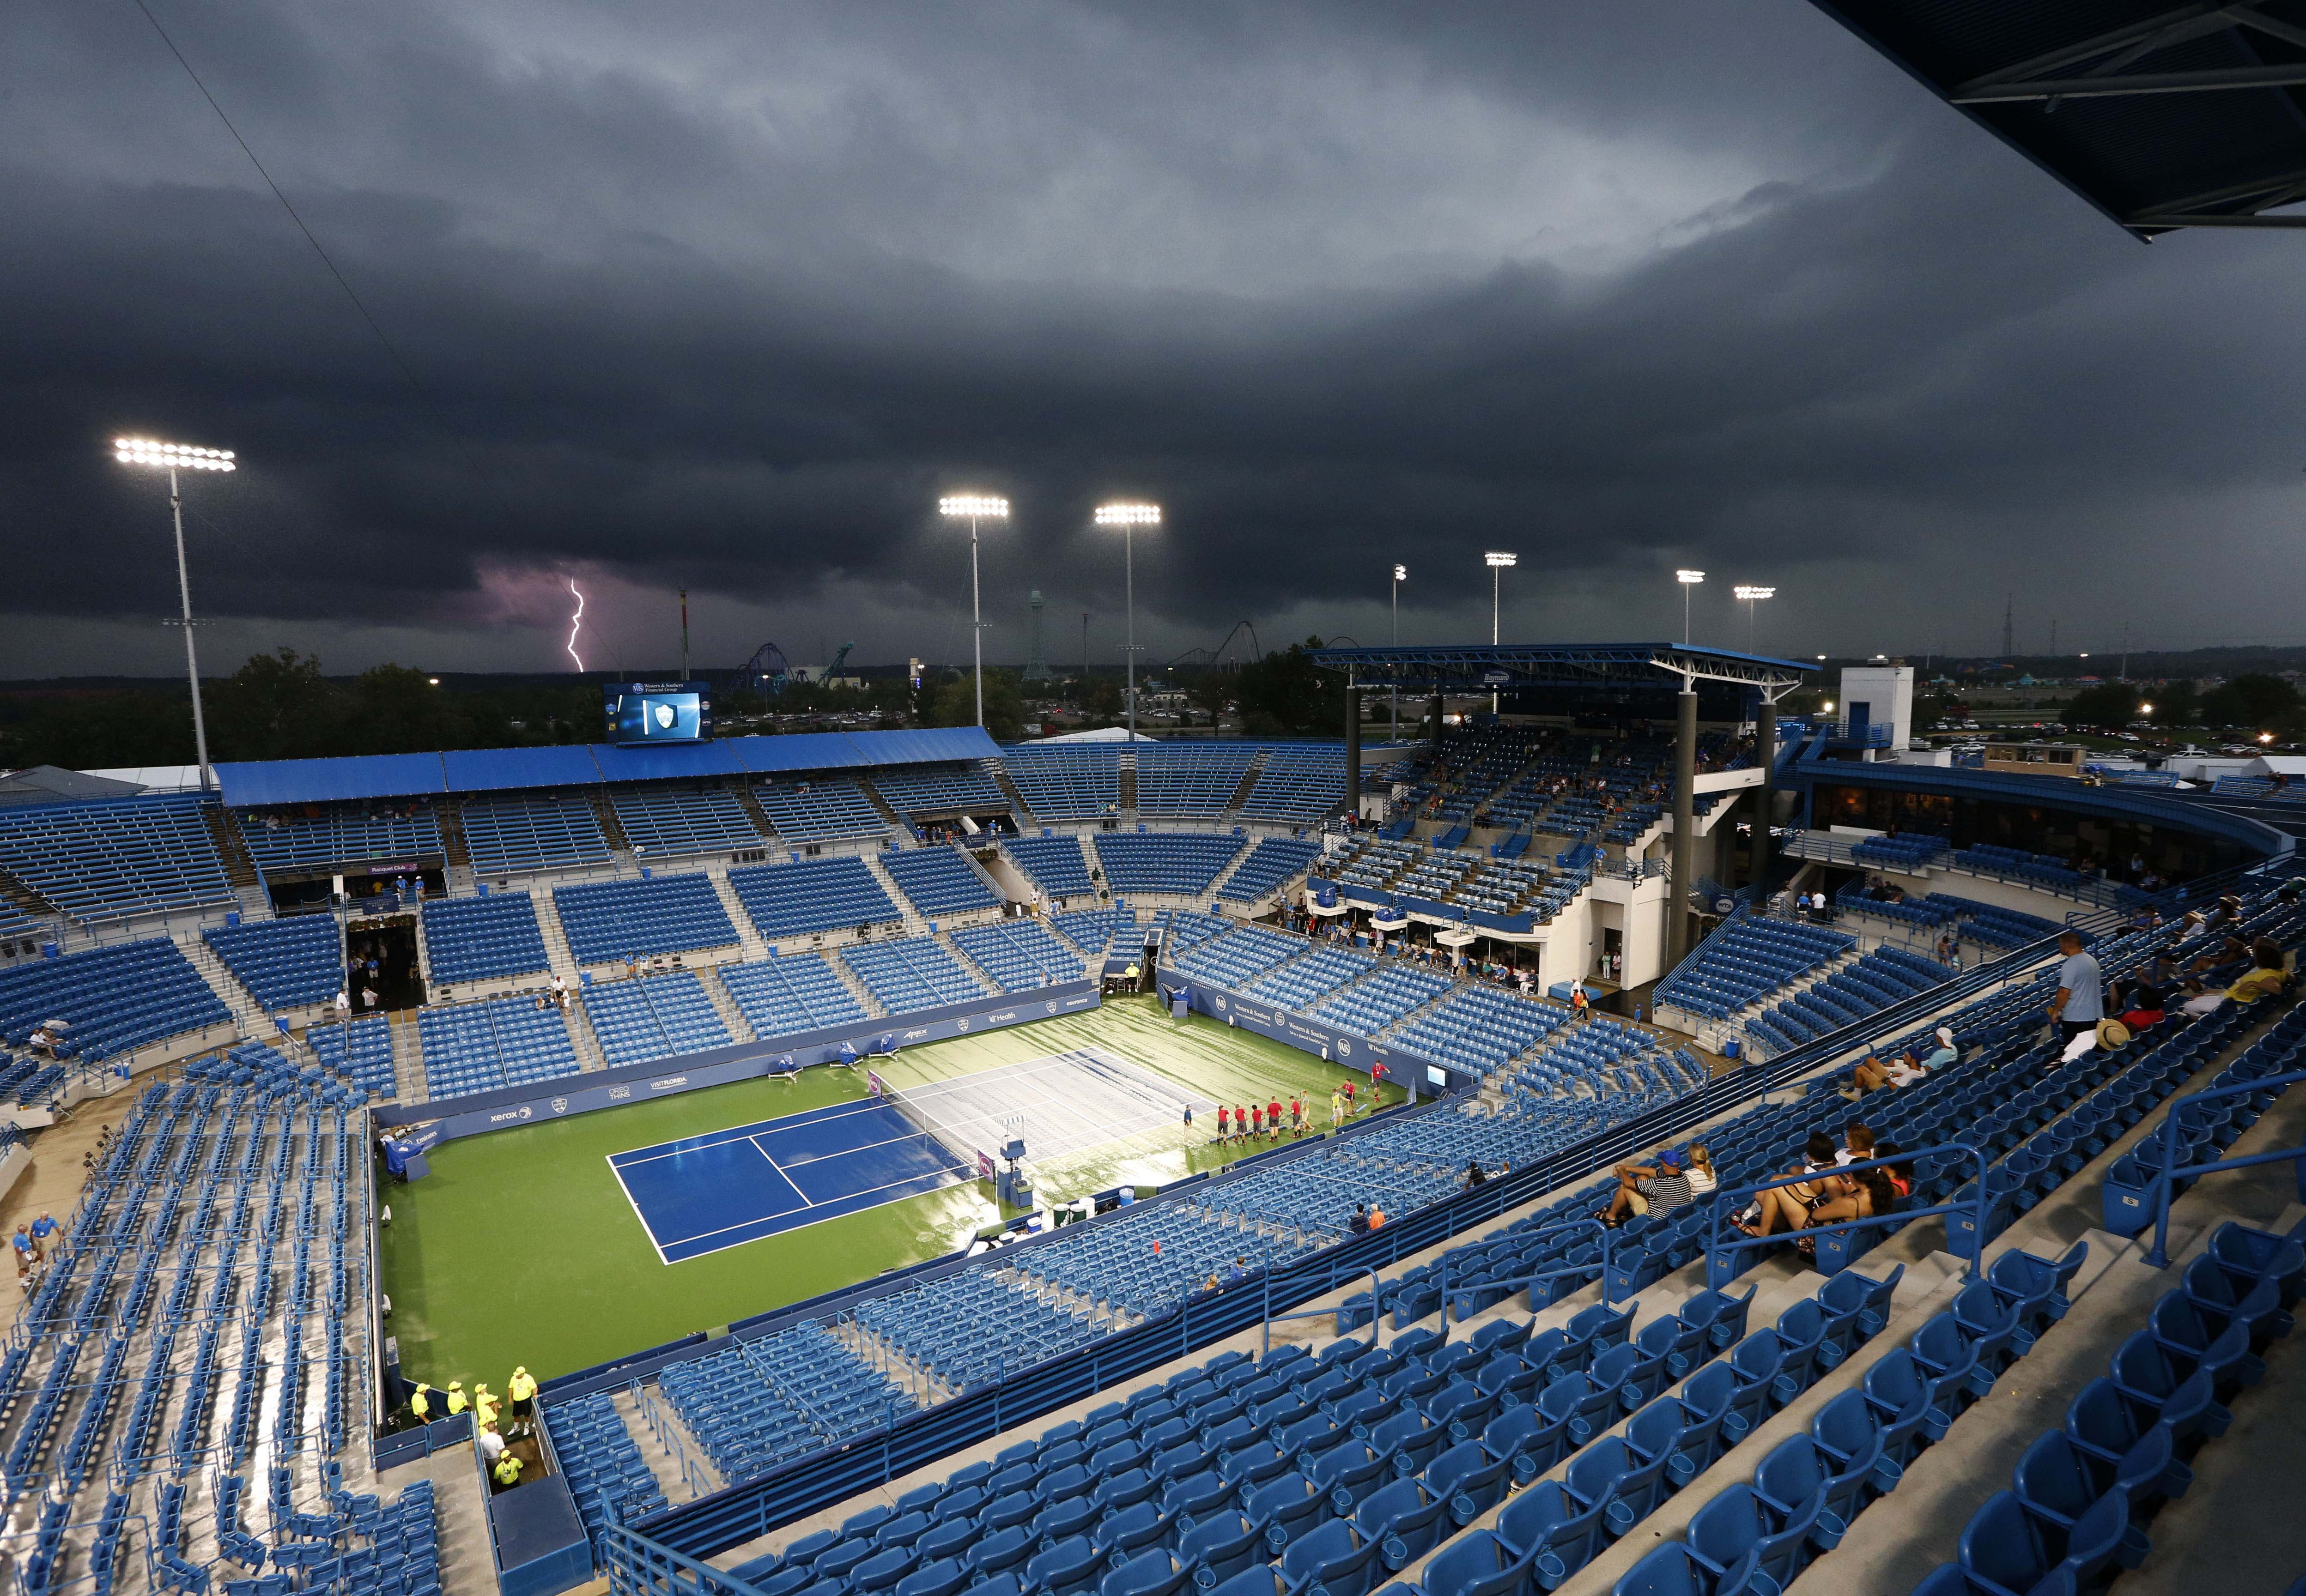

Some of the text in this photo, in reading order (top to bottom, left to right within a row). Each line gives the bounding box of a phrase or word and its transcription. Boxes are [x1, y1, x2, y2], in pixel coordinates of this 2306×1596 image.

[1066, 998, 1088, 1006] esurance
[997, 1012, 1015, 1022] Health
[1234, 1003, 1249, 1014] Western
[1254, 1010, 1270, 1021] Southern
[1288, 1022, 1305, 1033] Western
[1311, 1029, 1329, 1041] Southern
[1374, 1046, 1389, 1056] Health
[609, 1086, 629, 1094] OREO
[610, 1091, 630, 1100] THINS
[491, 1111, 517, 1122] xerox
[416, 1130, 437, 1144] Emirates
[980, 1160, 990, 1173] WTA
